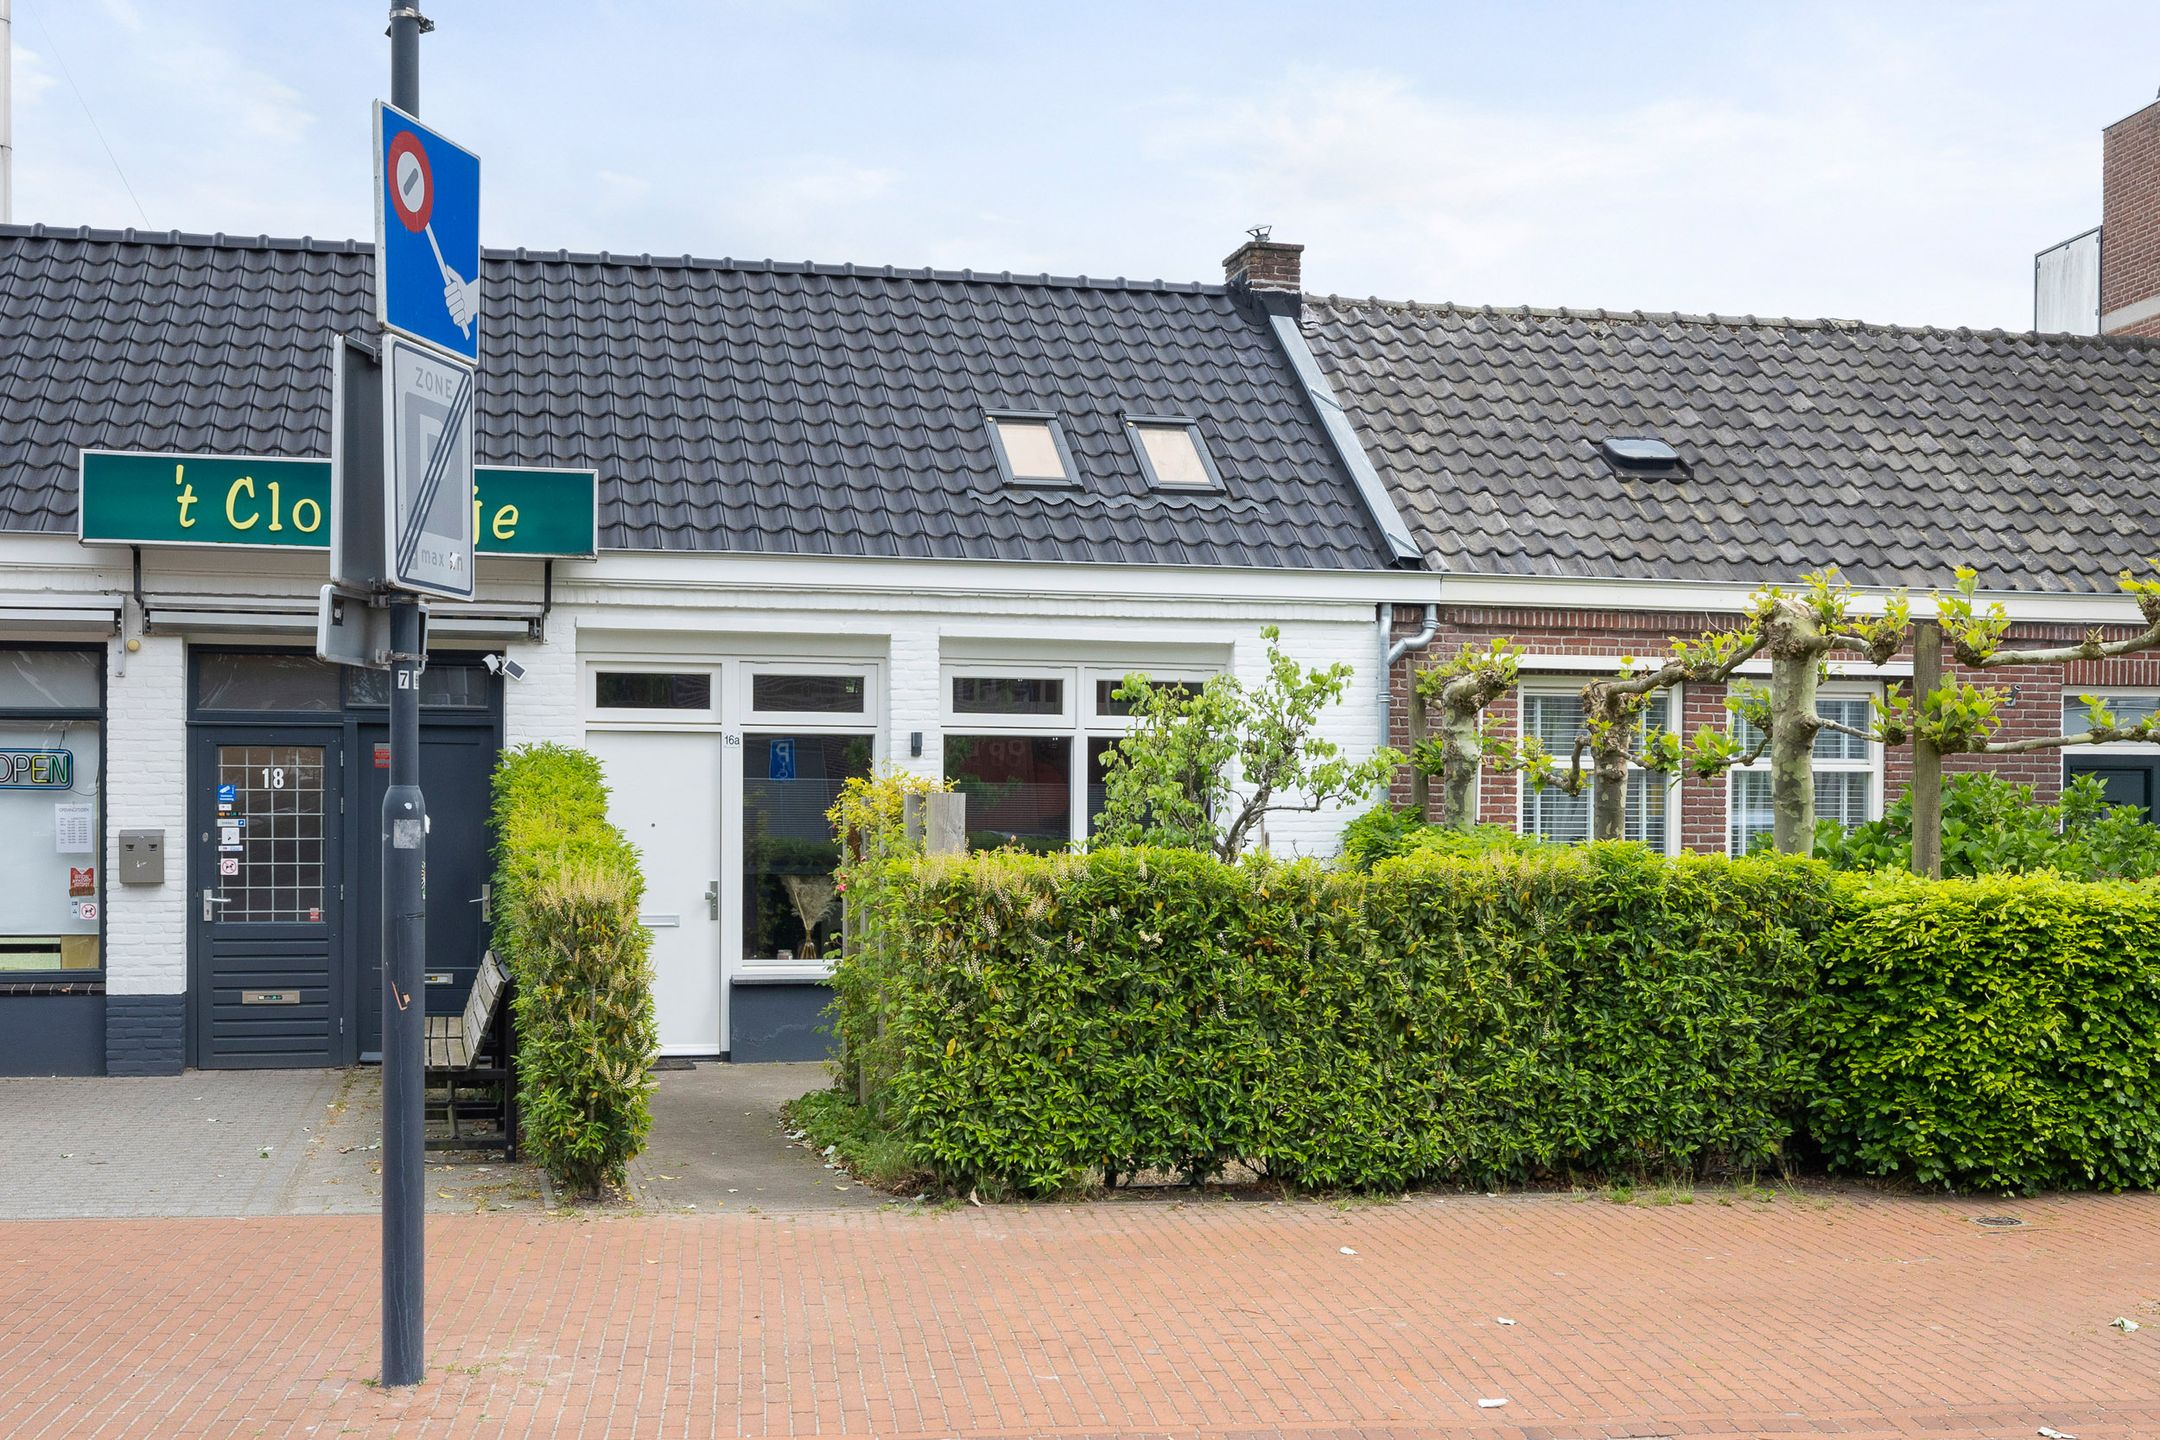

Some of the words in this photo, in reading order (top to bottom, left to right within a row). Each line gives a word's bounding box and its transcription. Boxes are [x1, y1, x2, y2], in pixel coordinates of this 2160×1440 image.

[415, 366, 453, 400] ZONE
[175, 464, 198, 528] 't
[225, 476, 519, 545] Cloje
[421, 548, 445, 568] max
[399, 672, 408, 687] 7
[724, 734, 740, 745] 16a
[0, 754, 68, 783] OPEN
[262, 767, 284, 789] 18
